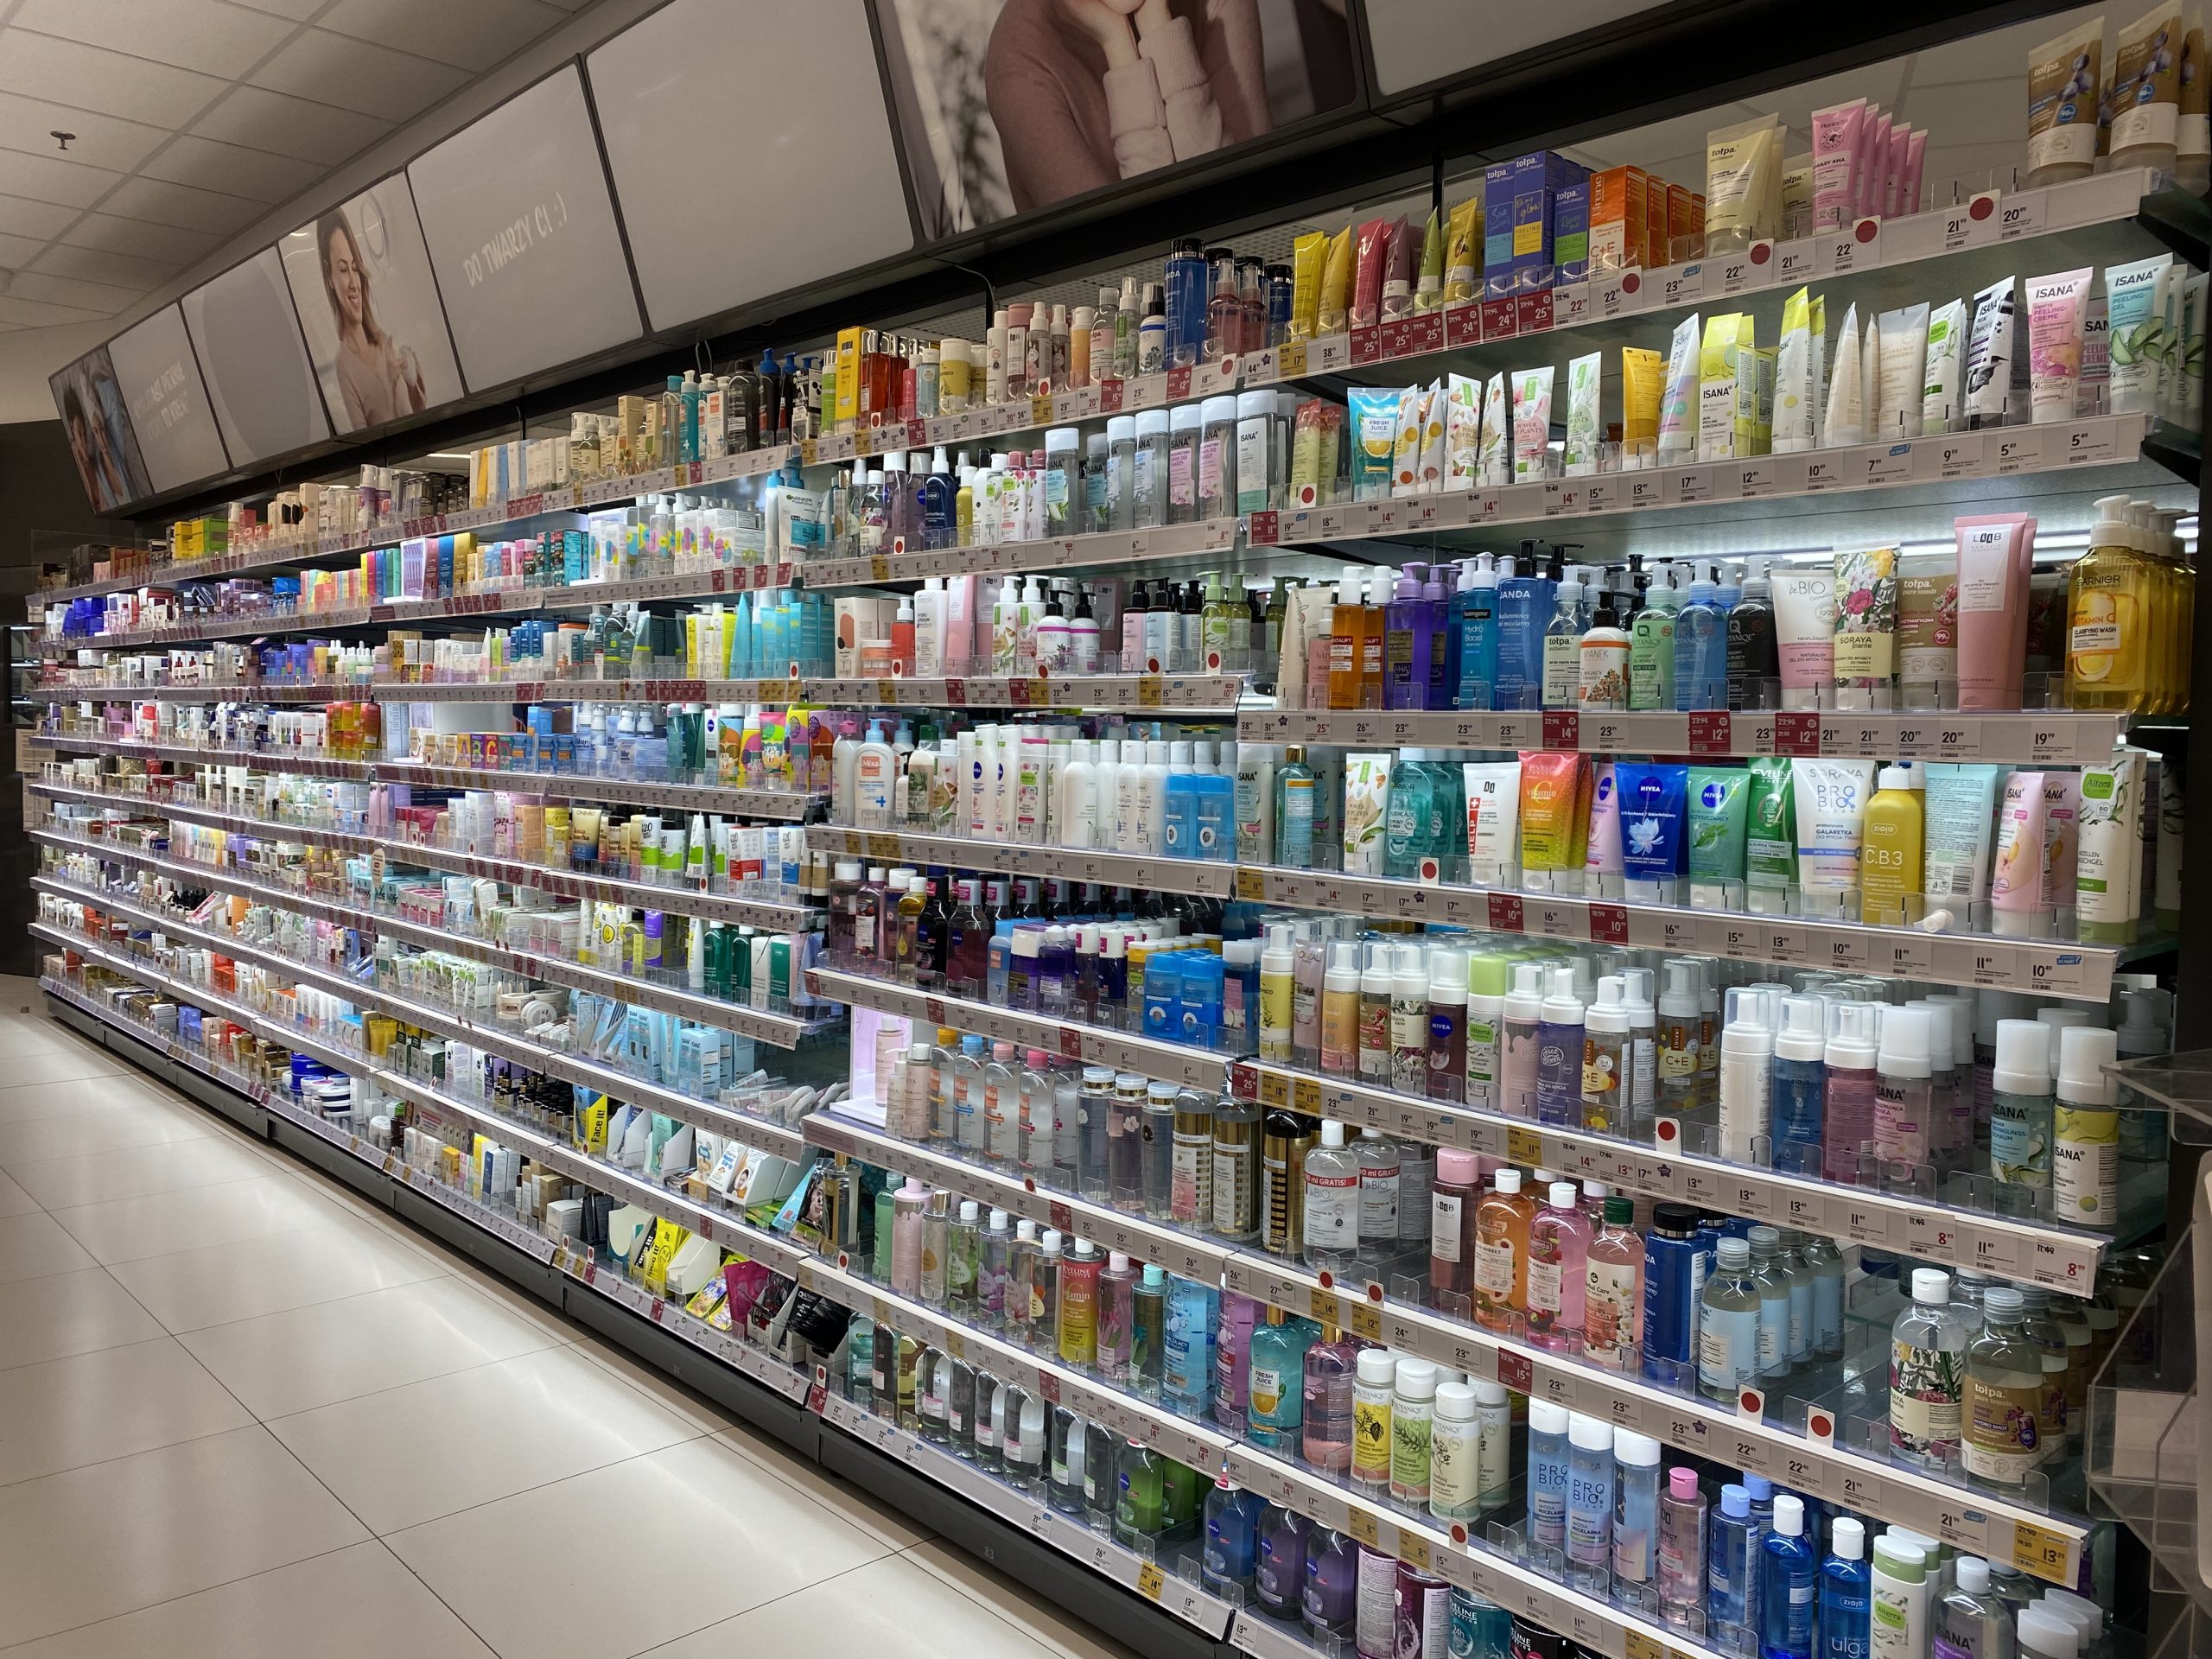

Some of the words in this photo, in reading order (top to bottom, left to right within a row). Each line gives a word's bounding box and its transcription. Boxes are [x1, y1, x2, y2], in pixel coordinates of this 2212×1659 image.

[463, 253, 482, 287] DO
[482, 214, 533, 274] TWARZY
[535, 204, 552, 238] CI
[1591, 242, 1615, 257] C+E
[2115, 270, 2152, 287] ISANA
[2036, 285, 2074, 299] ISANA
[2034, 314, 2058, 322] CREME
[2085, 321, 2108, 332] SAN
[1703, 388, 1729, 398] ISANA
[1500, 590, 1530, 600] JANDA
[1465, 626, 1483, 634] Hydro
[1584, 650, 1609, 659] VIANEK
[2086, 779, 2112, 789] Alterra
[1818, 785, 1854, 795] PRO
[1666, 1056, 1688, 1066] C+E
[591, 1120, 602, 1143] Face
[2056, 1147, 2081, 1161] SANA
[1596, 1286, 1610, 1294] Care
[1255, 1370, 1273, 1379] FRESH
[1574, 1479, 1605, 1494] PRO
[1877, 1606, 1901, 1622] Alterra
